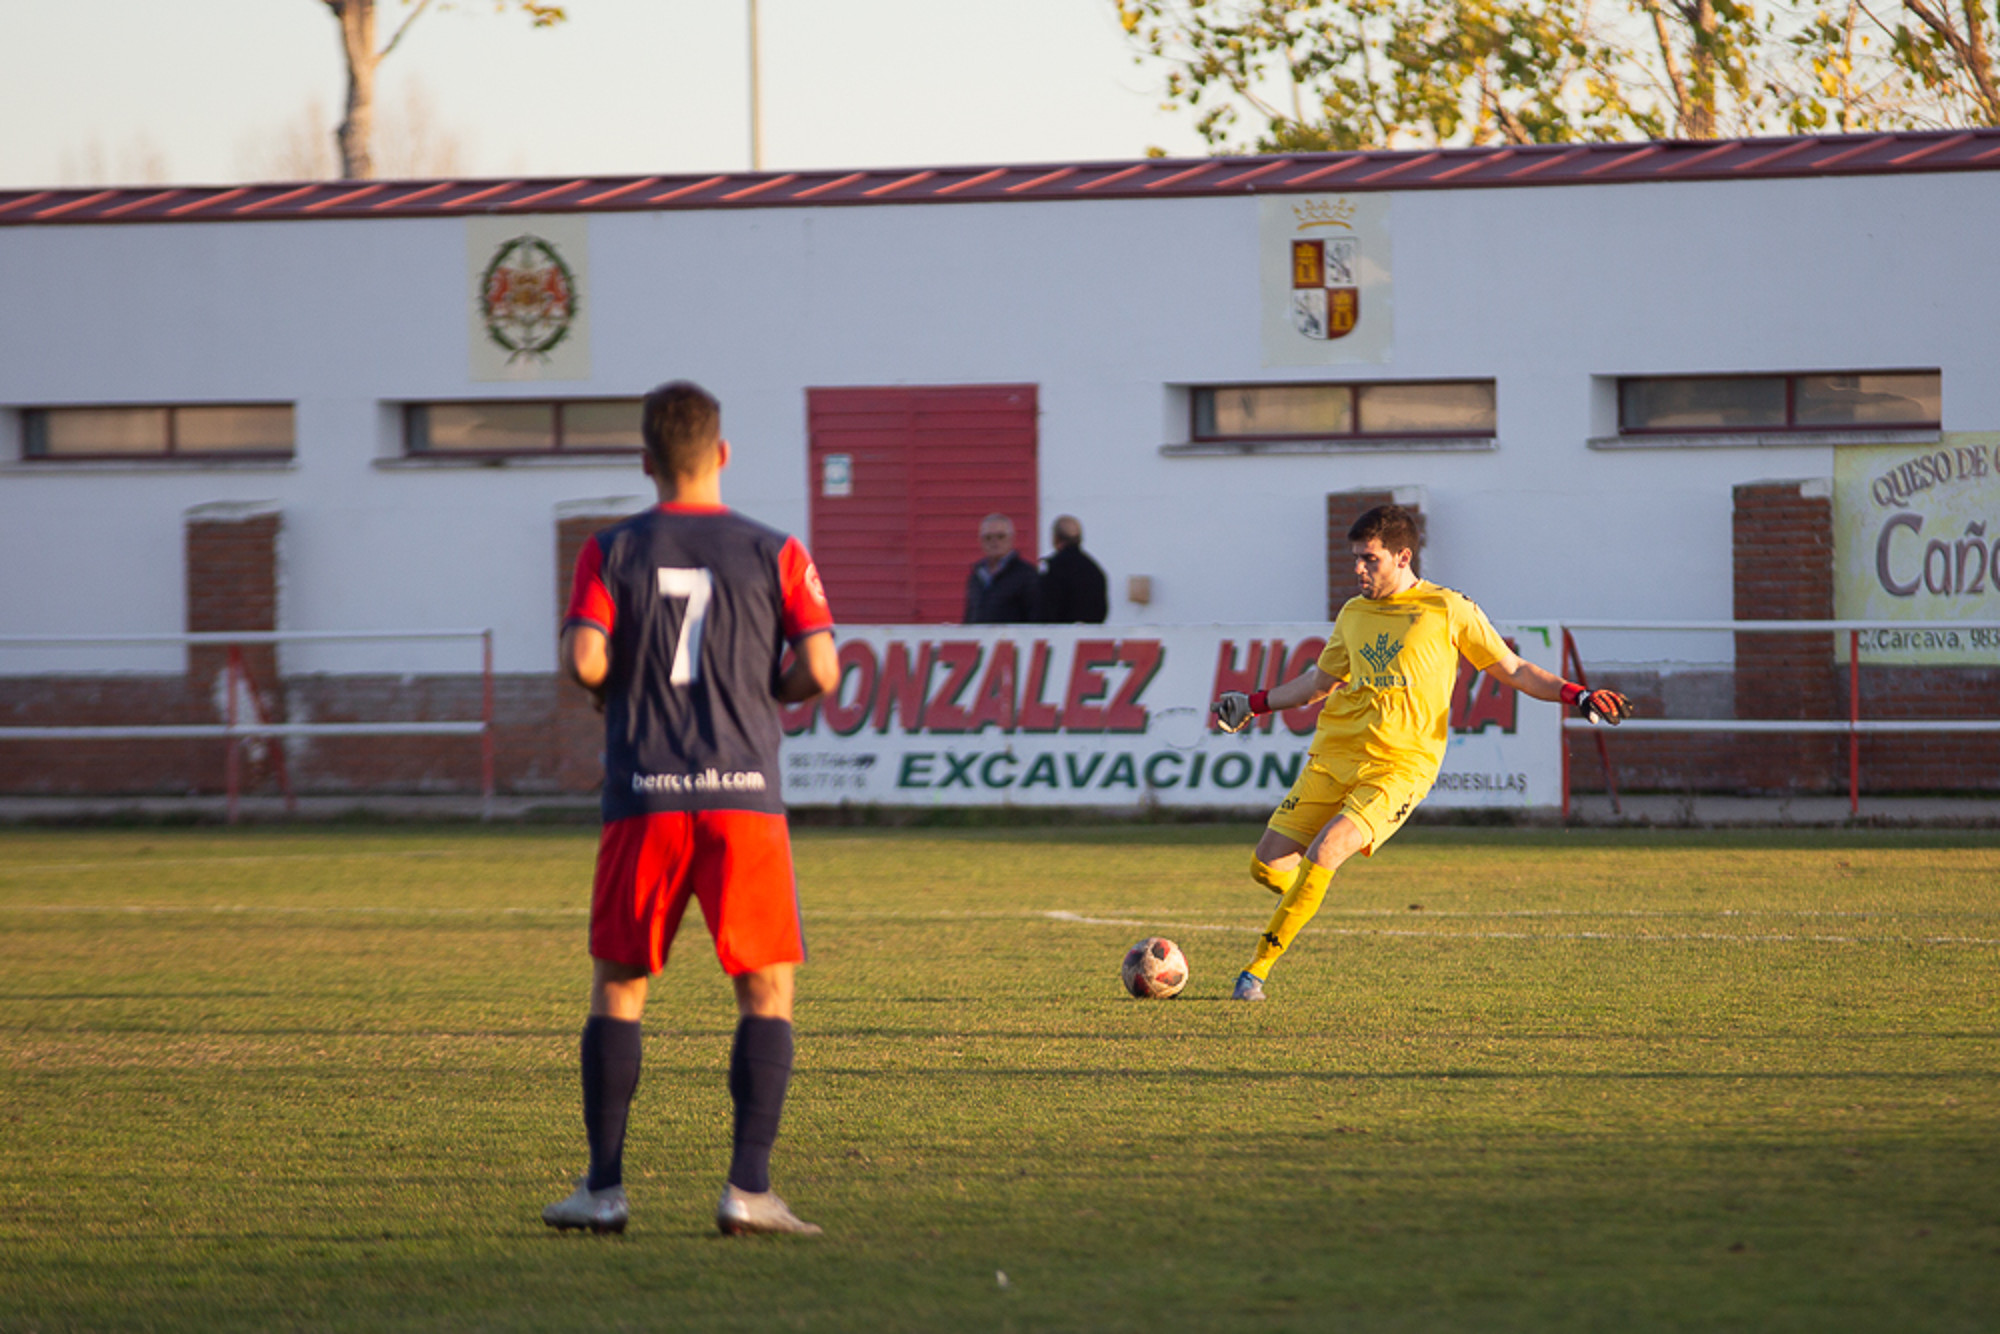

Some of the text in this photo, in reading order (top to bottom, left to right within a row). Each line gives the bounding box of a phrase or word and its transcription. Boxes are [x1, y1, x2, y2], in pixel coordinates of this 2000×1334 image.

[1872, 451, 1952, 507] QUESO
[1955, 445, 1988, 480] DE
[657, 566, 713, 686] 7
[1432, 771, 1528, 794] RDESILLAS
